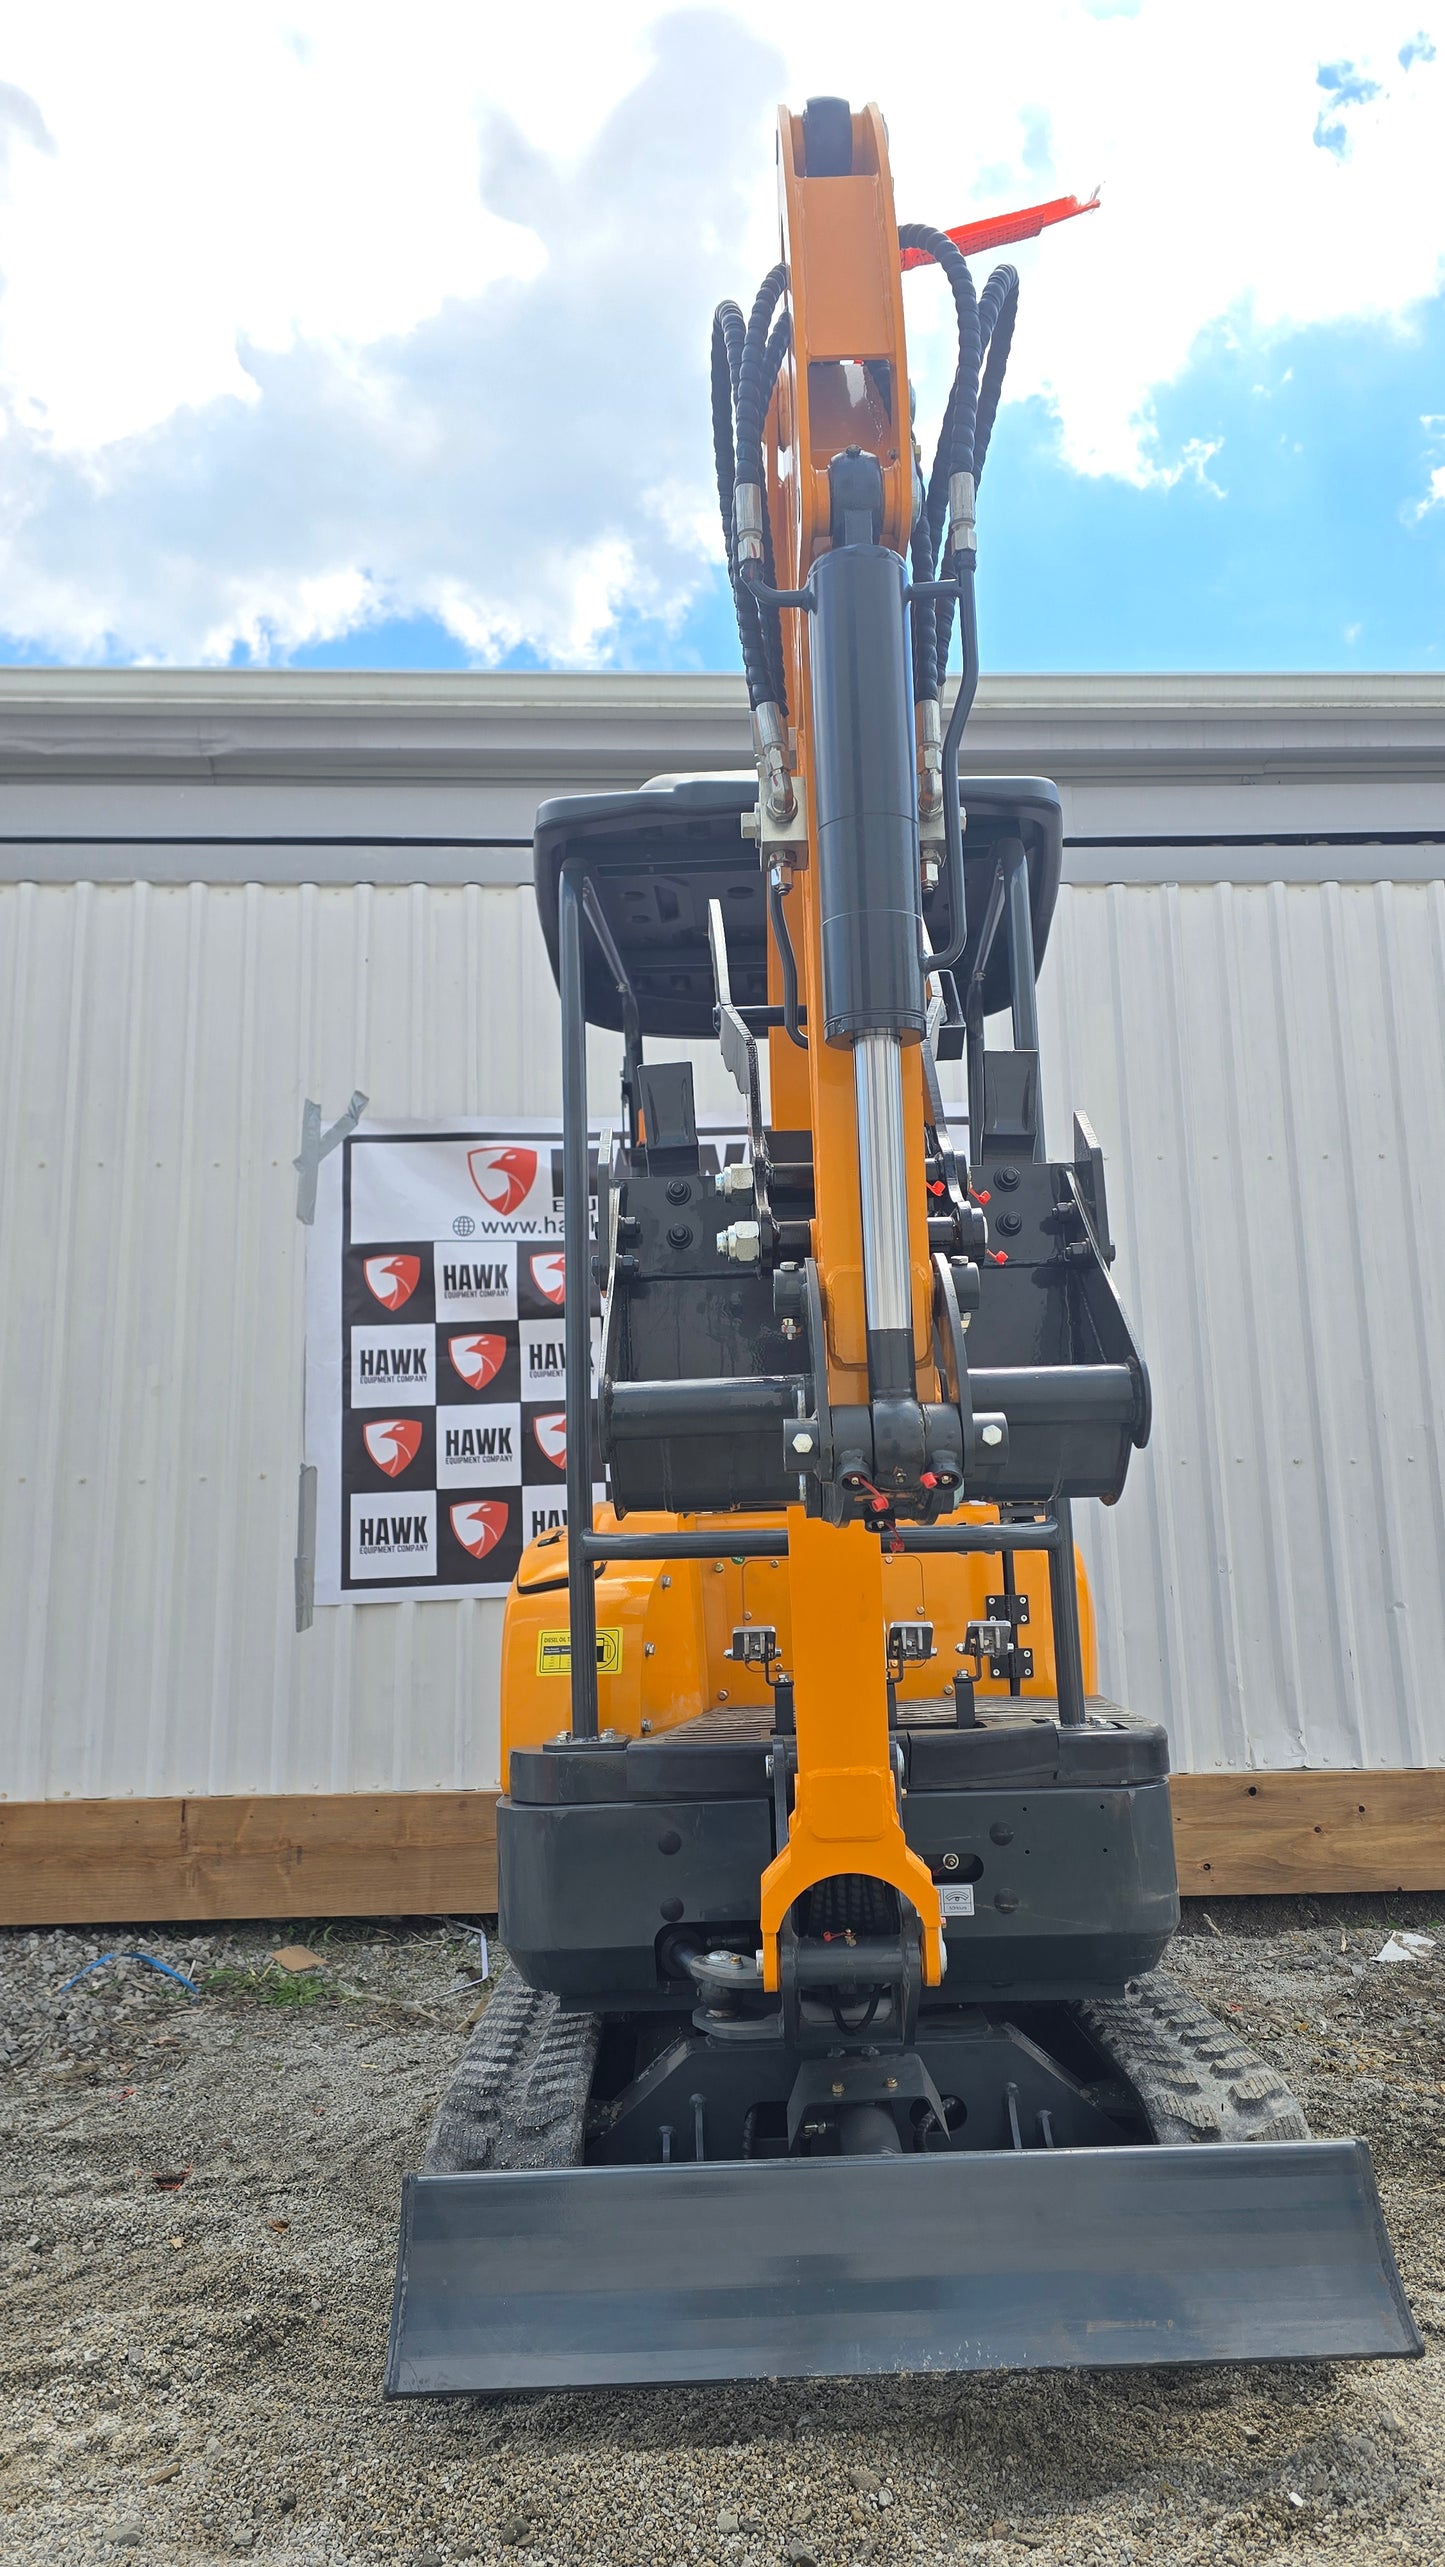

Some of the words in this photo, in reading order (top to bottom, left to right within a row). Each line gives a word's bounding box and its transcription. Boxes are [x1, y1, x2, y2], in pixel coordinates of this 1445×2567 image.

[443, 1264, 509, 1291] HAWK
[444, 1291, 478, 1299] EQUIPMENT
[479, 1290, 509, 1298] COMPANY
[360, 1348, 427, 1376] HAWK
[529, 1370, 564, 1379] EQUIPMENT
[360, 1376, 395, 1384] EQUIPMENT
[446, 1427, 512, 1456] HAWK
[445, 1456, 481, 1465] EQUIPMENT
[482, 1455, 513, 1463] COMPANY
[360, 1516, 428, 1546] HAWK
[360, 1546, 395, 1554] EQUIPMENT
[396, 1544, 429, 1553] COMPANY
